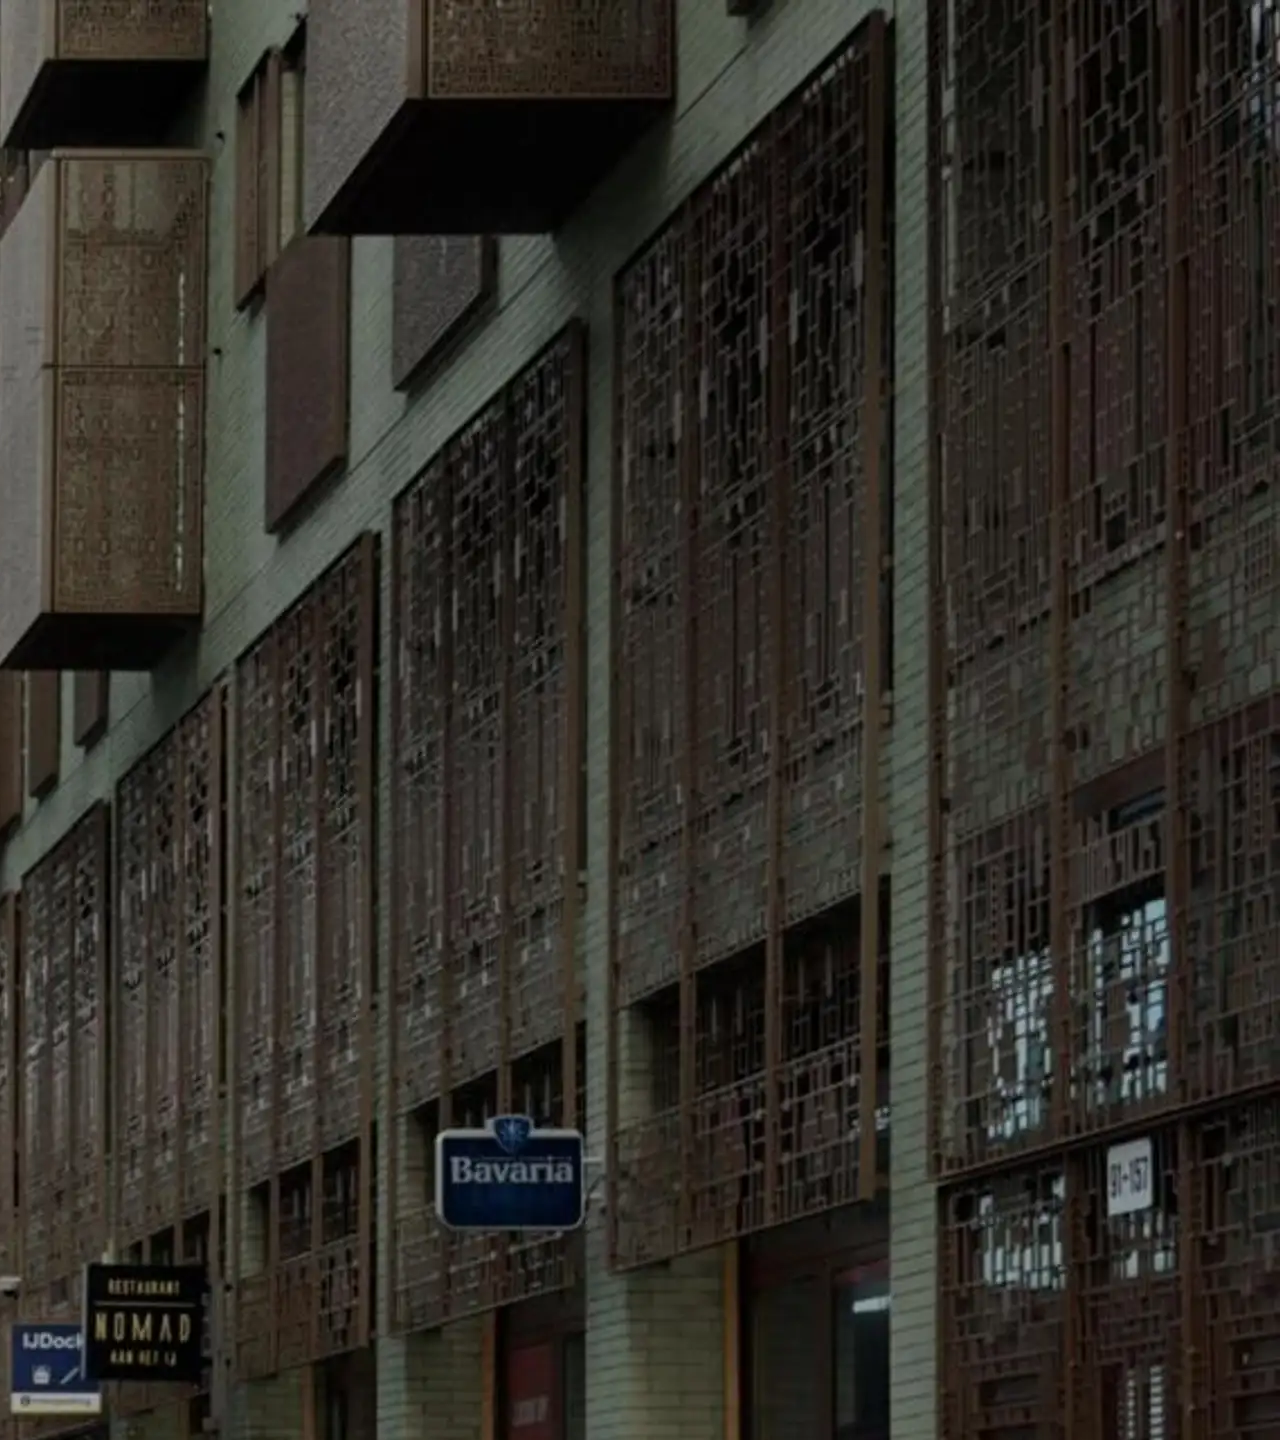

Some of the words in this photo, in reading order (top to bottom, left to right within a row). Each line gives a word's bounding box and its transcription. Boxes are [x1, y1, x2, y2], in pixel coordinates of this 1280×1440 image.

[450, 1155, 574, 1184] Bavaria
[107, 1277, 181, 1296] RESTAURANT
[94, 1311, 192, 1344] NOMAD
